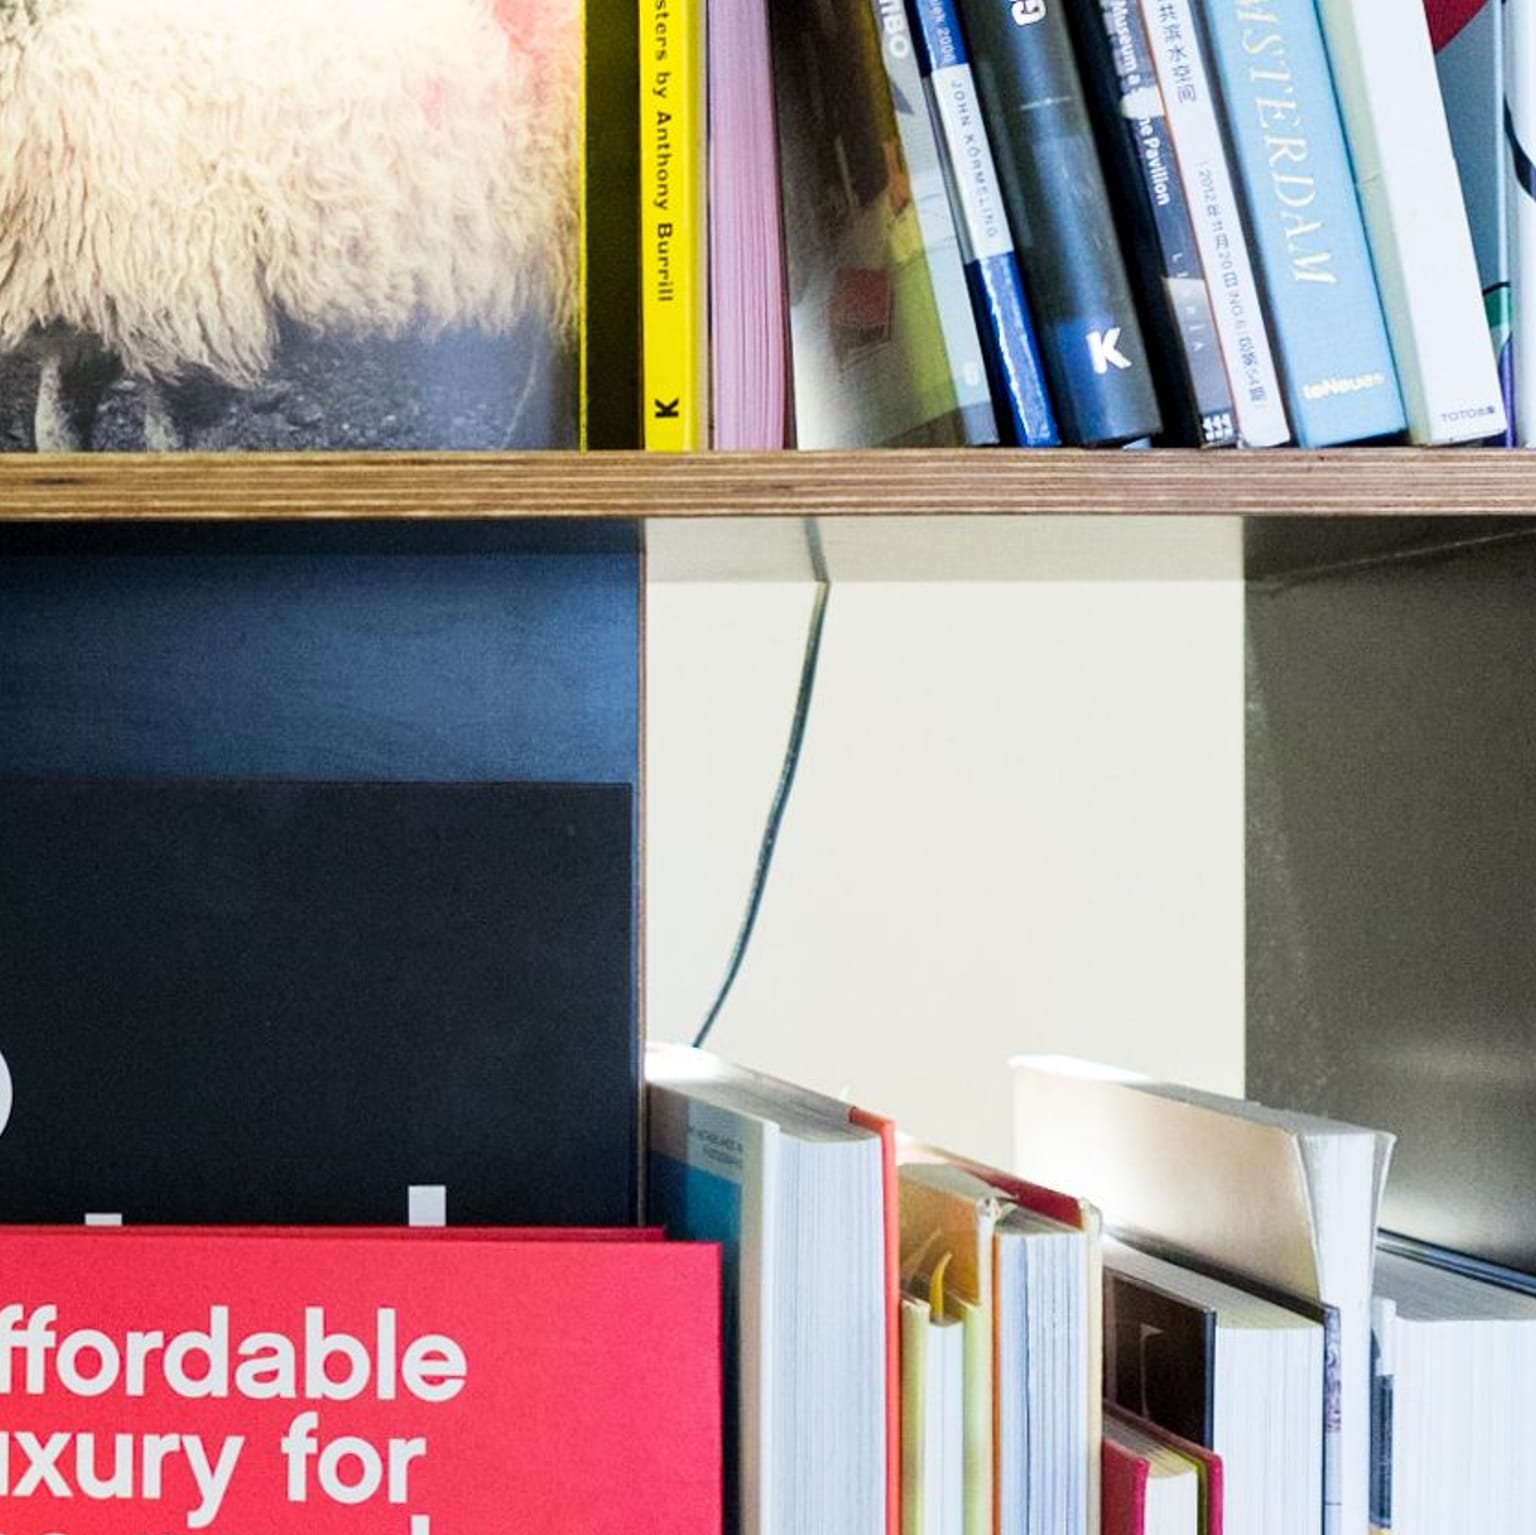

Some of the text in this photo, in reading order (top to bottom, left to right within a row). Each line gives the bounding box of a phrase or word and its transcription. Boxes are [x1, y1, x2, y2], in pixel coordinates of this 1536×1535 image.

[651, 71, 672, 99] by
[949, 78, 972, 128] JOHN
[1115, 0, 1143, 71] Museum
[1130, 85, 1155, 136] Sne
[1143, 135, 1171, 207] Pavilion
[652, 110, 673, 212] Anthony
[657, 222, 674, 303] Burrill
[1171, 251, 1204, 353] LIRIA
[1084, 327, 1132, 375] K
[653, 397, 679, 419] K
[280, 1410, 426, 1505] for
